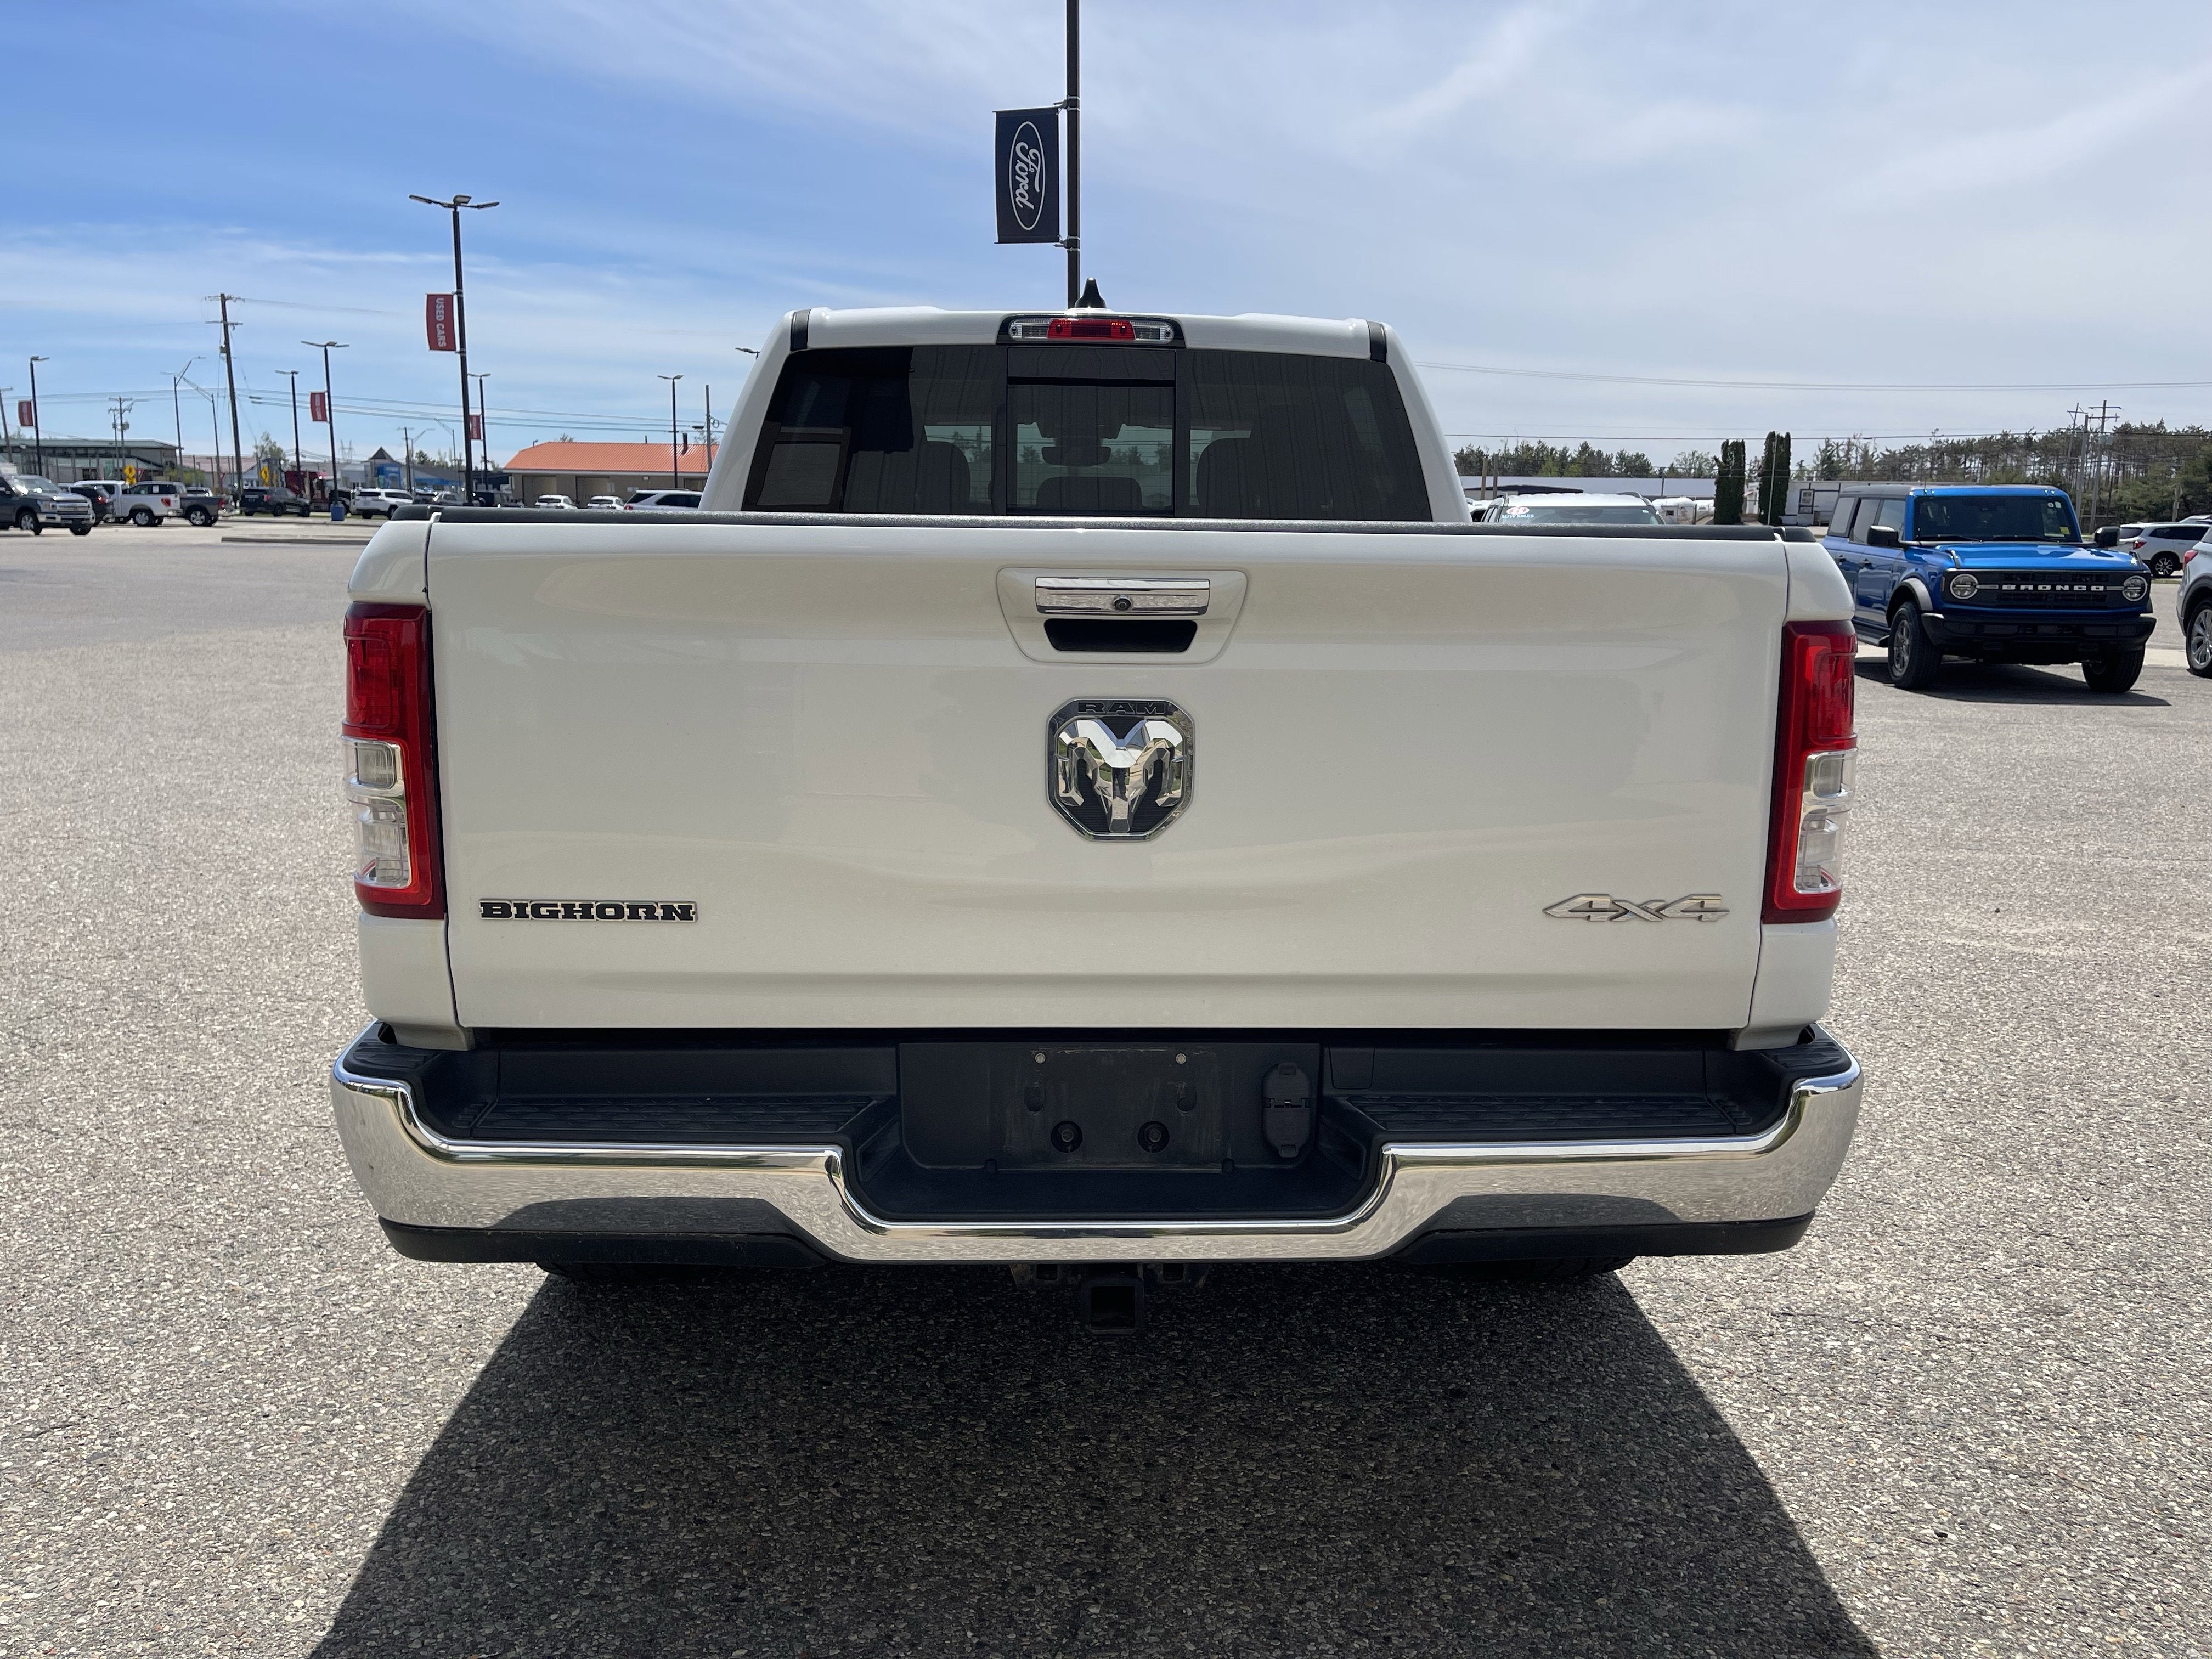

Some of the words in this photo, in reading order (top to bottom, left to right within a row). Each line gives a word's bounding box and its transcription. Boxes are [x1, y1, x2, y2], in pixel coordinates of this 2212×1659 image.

[1015, 141, 1041, 210] Ford
[436, 297, 444, 321] USED
[436, 323, 447, 347] CARS
[1077, 702, 1165, 714] RAM
[479, 899, 697, 922] BIGHORN
